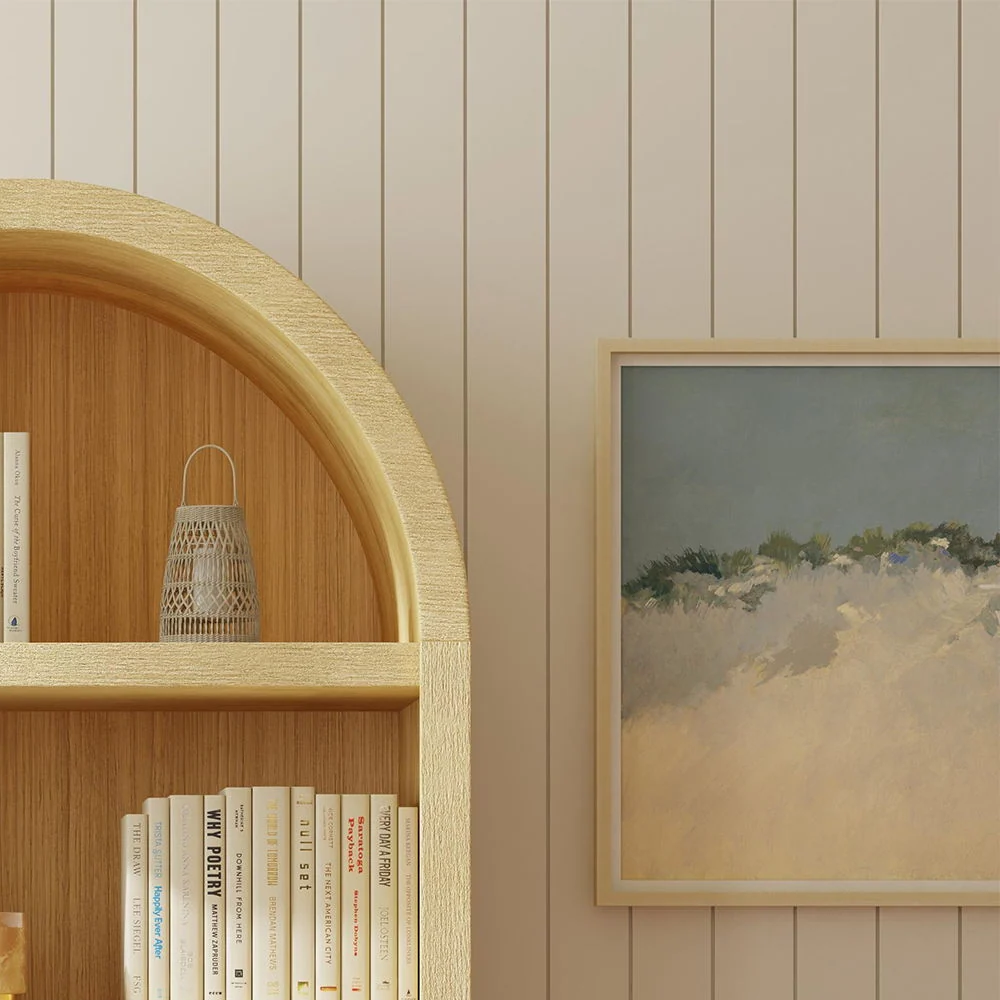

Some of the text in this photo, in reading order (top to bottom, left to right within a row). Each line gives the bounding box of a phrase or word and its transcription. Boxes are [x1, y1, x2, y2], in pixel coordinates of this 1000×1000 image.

[11, 546, 20, 577] Boyfriend
[133, 823, 141, 876] THE DRAW
[154, 822, 162, 846] TRISTA
[347, 818, 355, 872] Payback
[357, 816, 365, 874] Saratoga
[379, 834, 390, 849] DAY
[207, 809, 221, 897] WHY POETRY
[300, 820, 312, 890] null set
[379, 859, 390, 887] FRIDAY
[152, 886, 163, 916] Happily
[132, 919, 141, 954] SIEGEL
[406, 917, 411, 925] OF
[154, 938, 162, 959] After
[380, 929, 389, 960] OSTEEN
